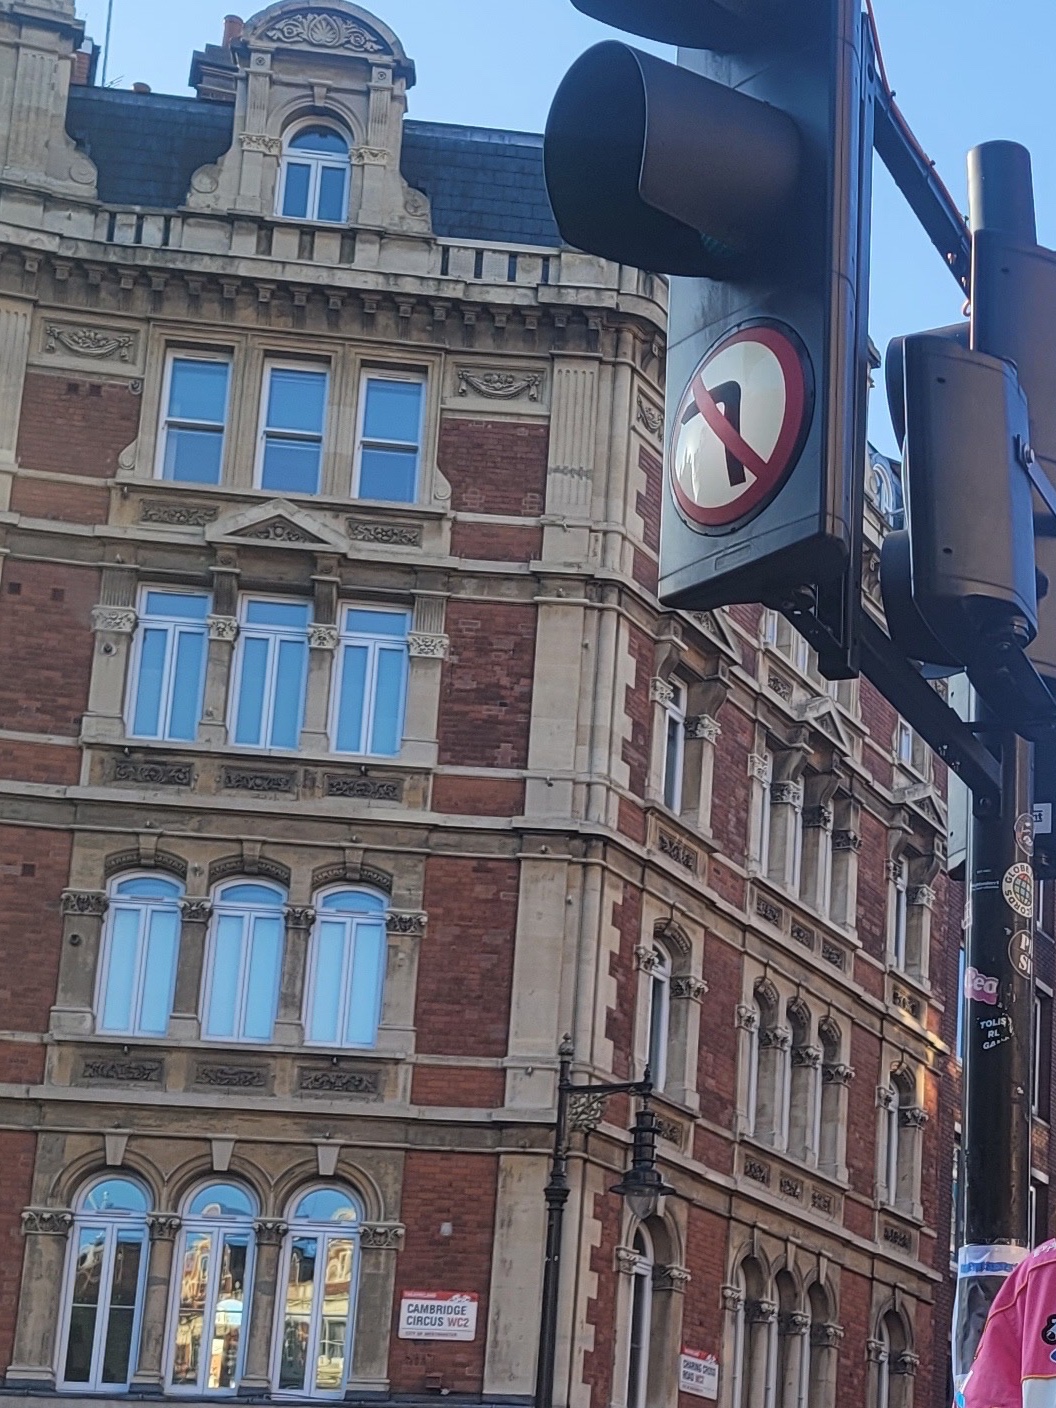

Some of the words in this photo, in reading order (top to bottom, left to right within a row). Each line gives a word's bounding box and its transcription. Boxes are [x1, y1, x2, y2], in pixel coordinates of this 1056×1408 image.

[407, 1303, 467, 1316] CAMBRIDGE
[406, 1315, 444, 1327] CIRCUS
[447, 1317, 470, 1328] WC2
